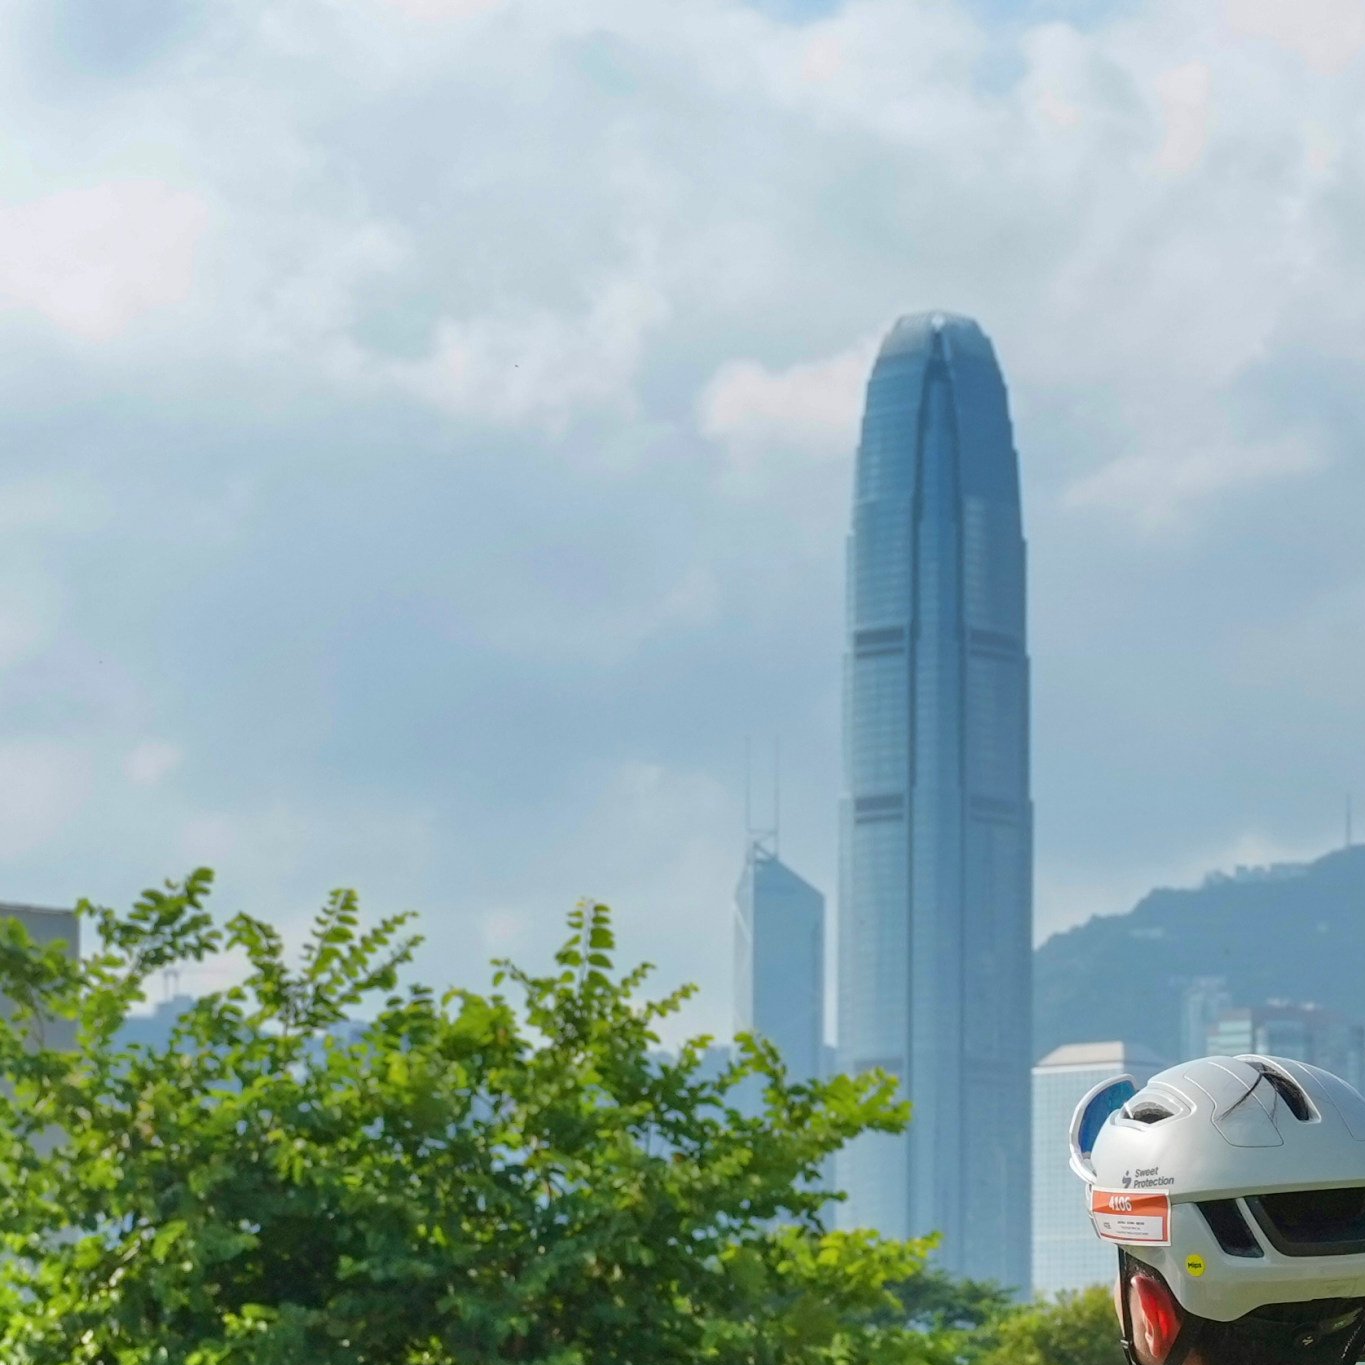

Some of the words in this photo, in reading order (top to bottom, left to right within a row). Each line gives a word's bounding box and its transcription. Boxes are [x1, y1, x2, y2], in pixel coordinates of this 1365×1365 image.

[1135, 1167, 1159, 1178] Sweet
[1134, 1176, 1175, 1189] Protection
[1108, 1196, 1132, 1212] 4106
